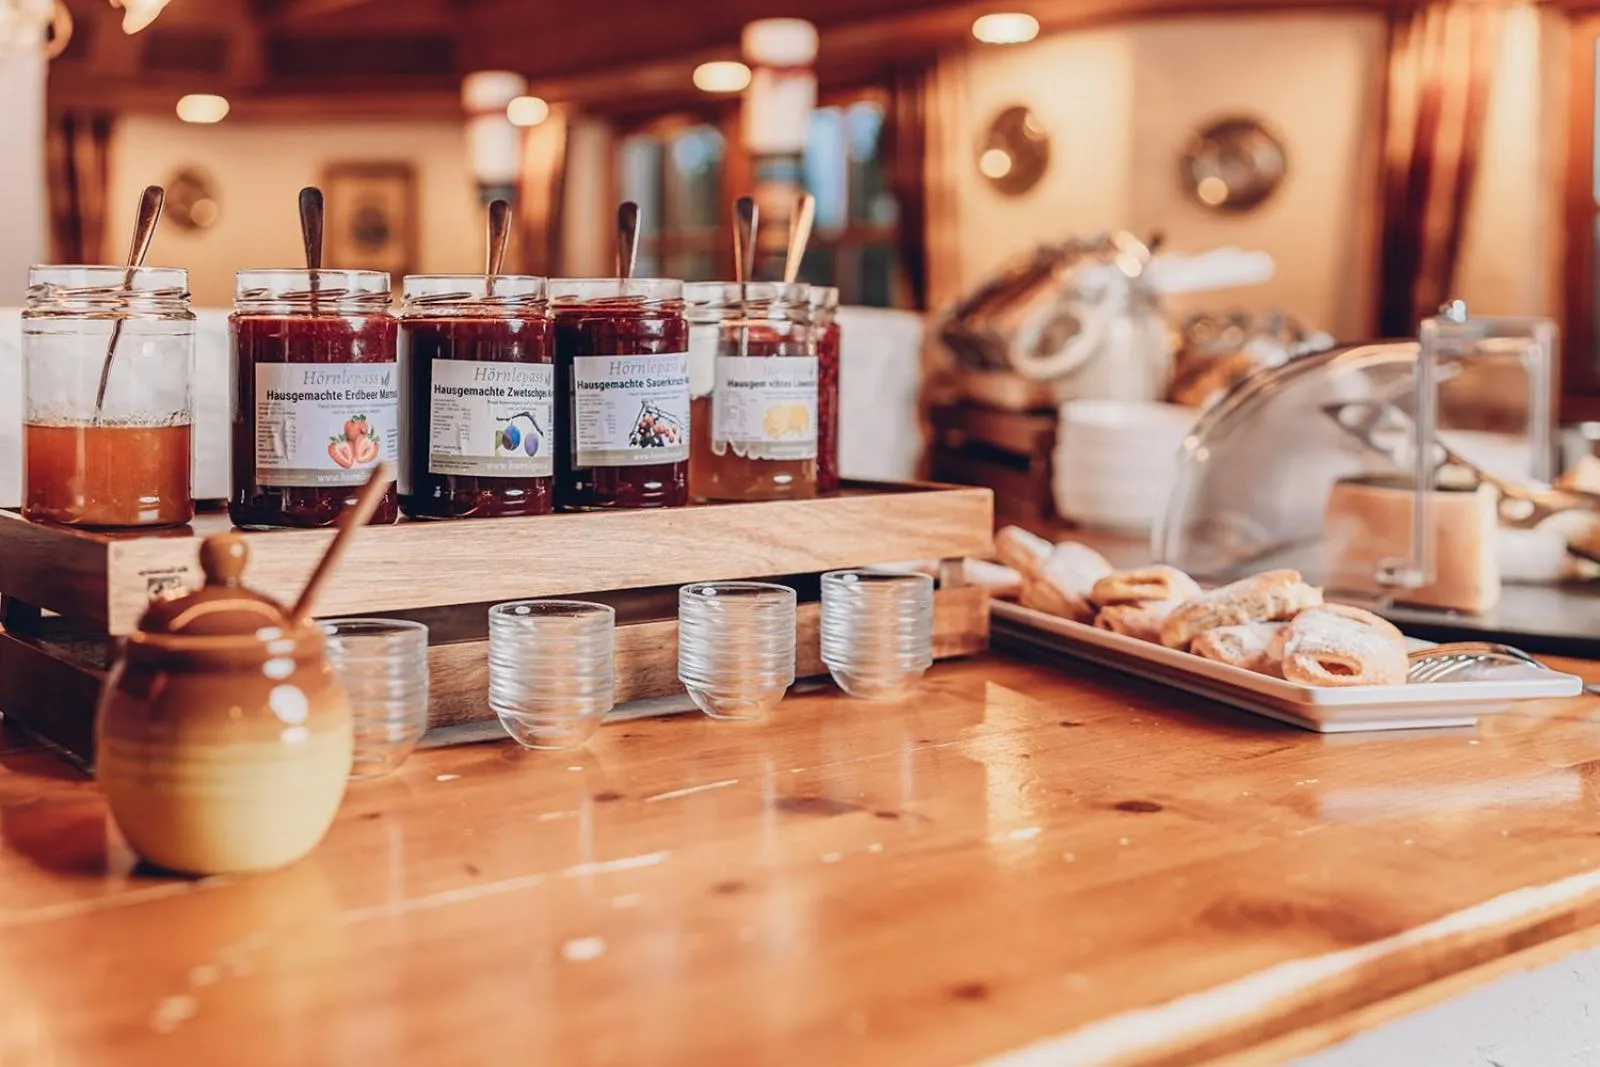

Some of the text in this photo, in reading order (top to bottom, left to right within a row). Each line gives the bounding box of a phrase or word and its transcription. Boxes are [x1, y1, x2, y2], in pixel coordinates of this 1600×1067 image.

[473, 366, 543, 384] Hörnlepass
[434, 384, 505, 398] Hausgemachte
[577, 380, 644, 391] Hausgemachte
[266, 389, 342, 403] Hausgemachte
[345, 388, 378, 400] Erdbeer
